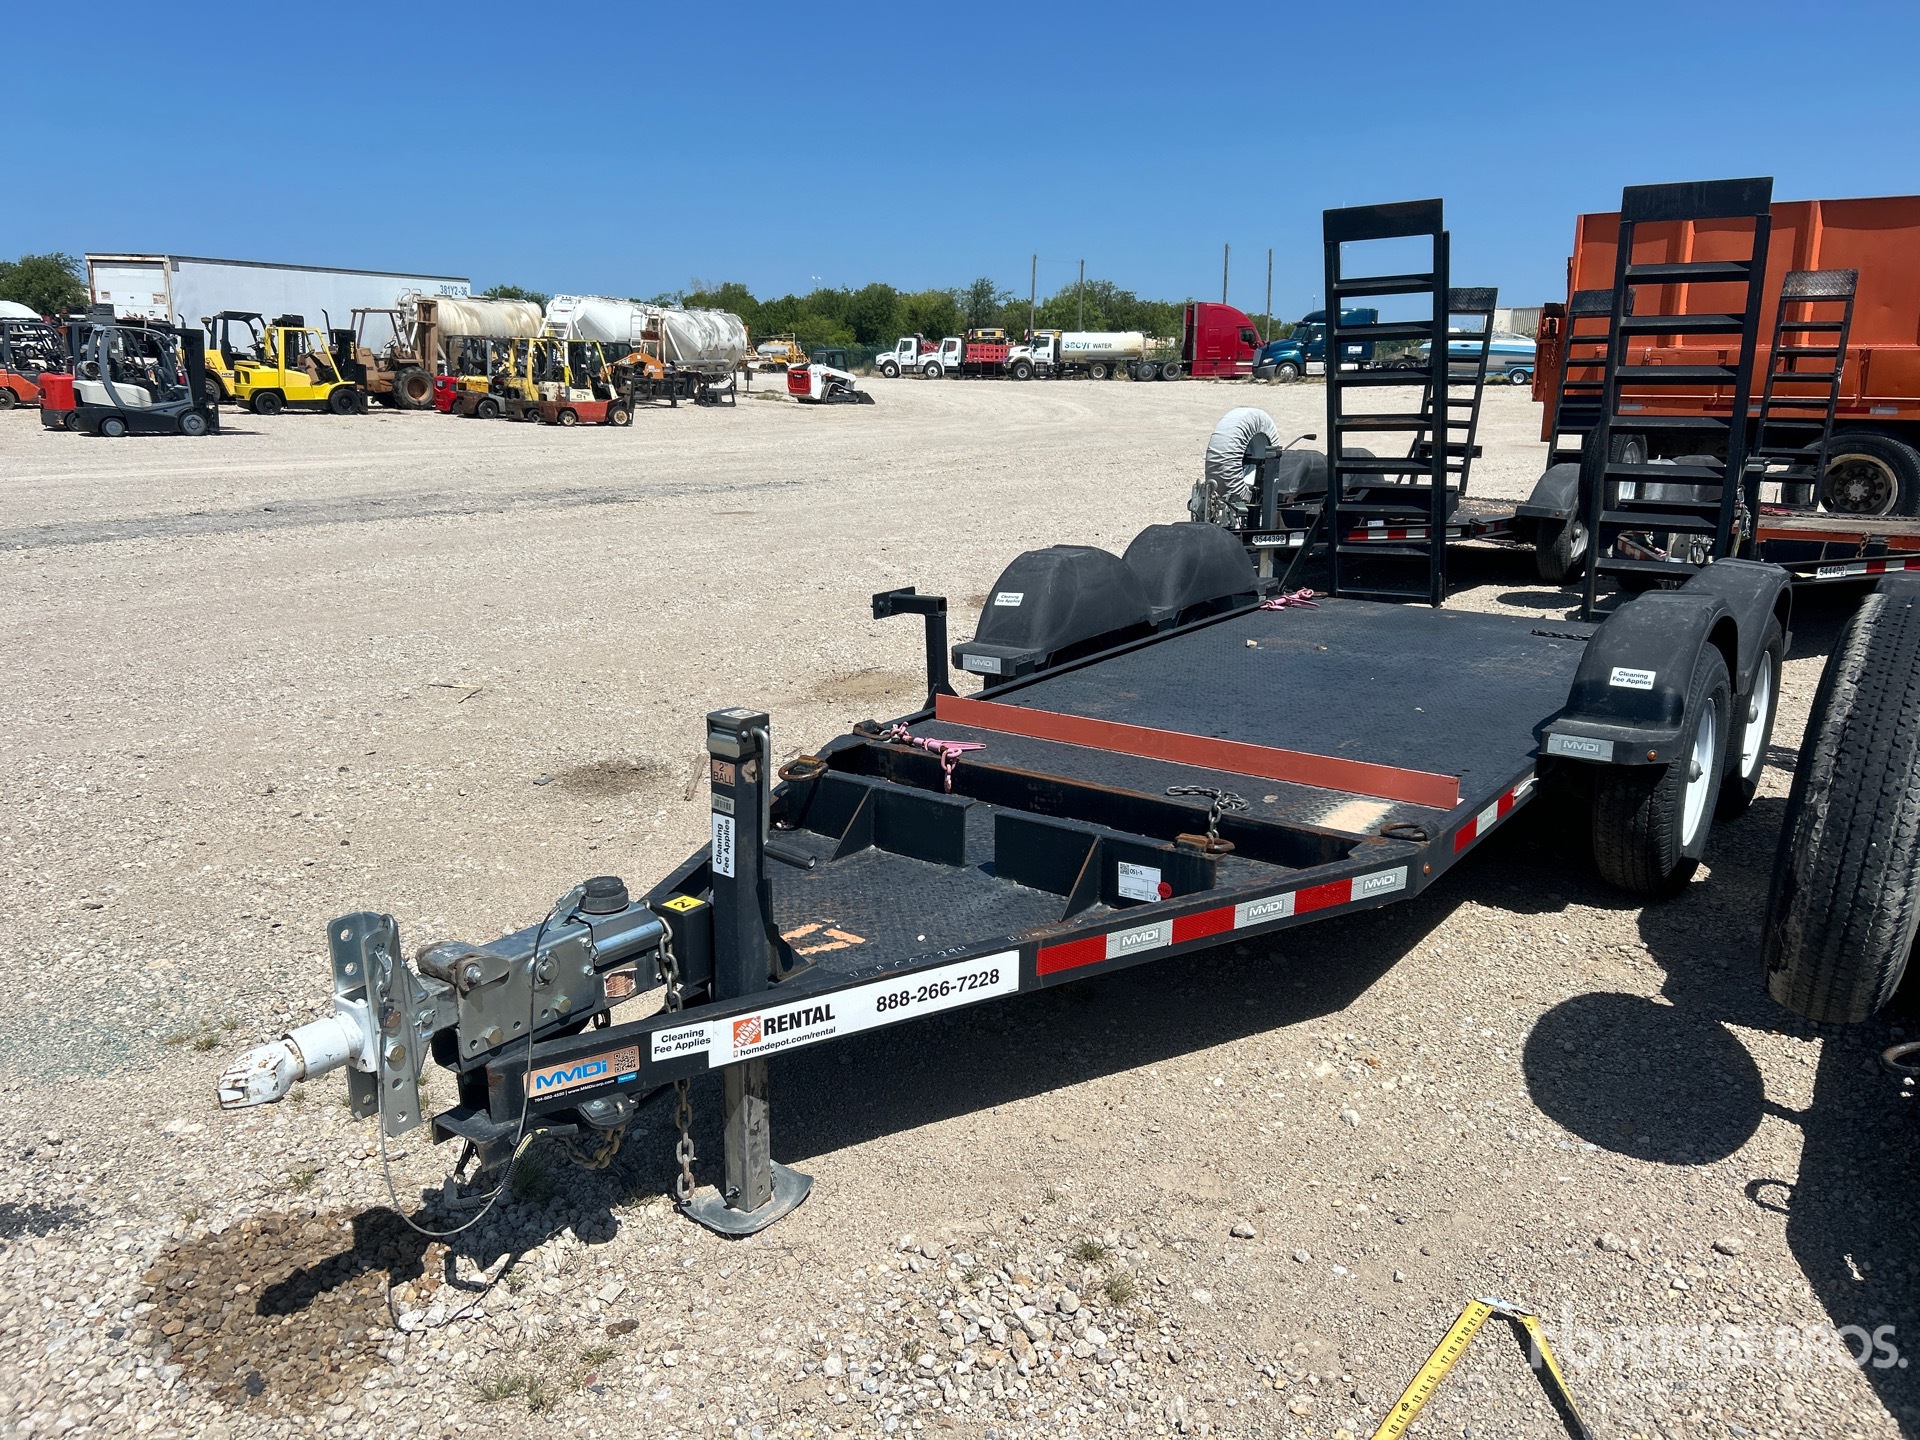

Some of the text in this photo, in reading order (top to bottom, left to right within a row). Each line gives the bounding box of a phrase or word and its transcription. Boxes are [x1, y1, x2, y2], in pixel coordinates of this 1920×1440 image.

[440, 285, 467, 296] 381Y2-36
[1618, 670, 1649, 680] Cleaning
[1626, 678, 1652, 686] Applies
[1563, 740, 1599, 752] MMDi
[713, 771, 734, 785] BALL
[715, 823, 724, 865] Cleaning
[1364, 874, 1395, 890] MMDi
[1250, 900, 1283, 917] MMDi
[1122, 929, 1159, 946] MMDi
[876, 968, 1000, 1012] 888-266-7228
[763, 1003, 836, 1036] RENTAL
[661, 1029, 704, 1043] Cleaning
[734, 1016, 761, 1047] HOME
[654, 1036, 711, 1055] Fee Applies
[740, 1026, 836, 1057] homedepot.com/rental
[535, 1059, 608, 1090] MMDi
[1388, 1424, 1399, 1434] 10
[1396, 1414, 1407, 1424] 11
[1412, 1394, 1423, 1403] 13
[1419, 1384, 1430, 1393] 14
[1426, 1374, 1437, 1383] 15
[1440, 1355, 1450, 1364] 17
[1448, 1345, 1458, 1355] 18
[1455, 1336, 1465, 1345] 19
[1461, 1326, 1472, 1336] 20
[1468, 1317, 1478, 1327] 21
[1475, 1307, 1486, 1317] 22
